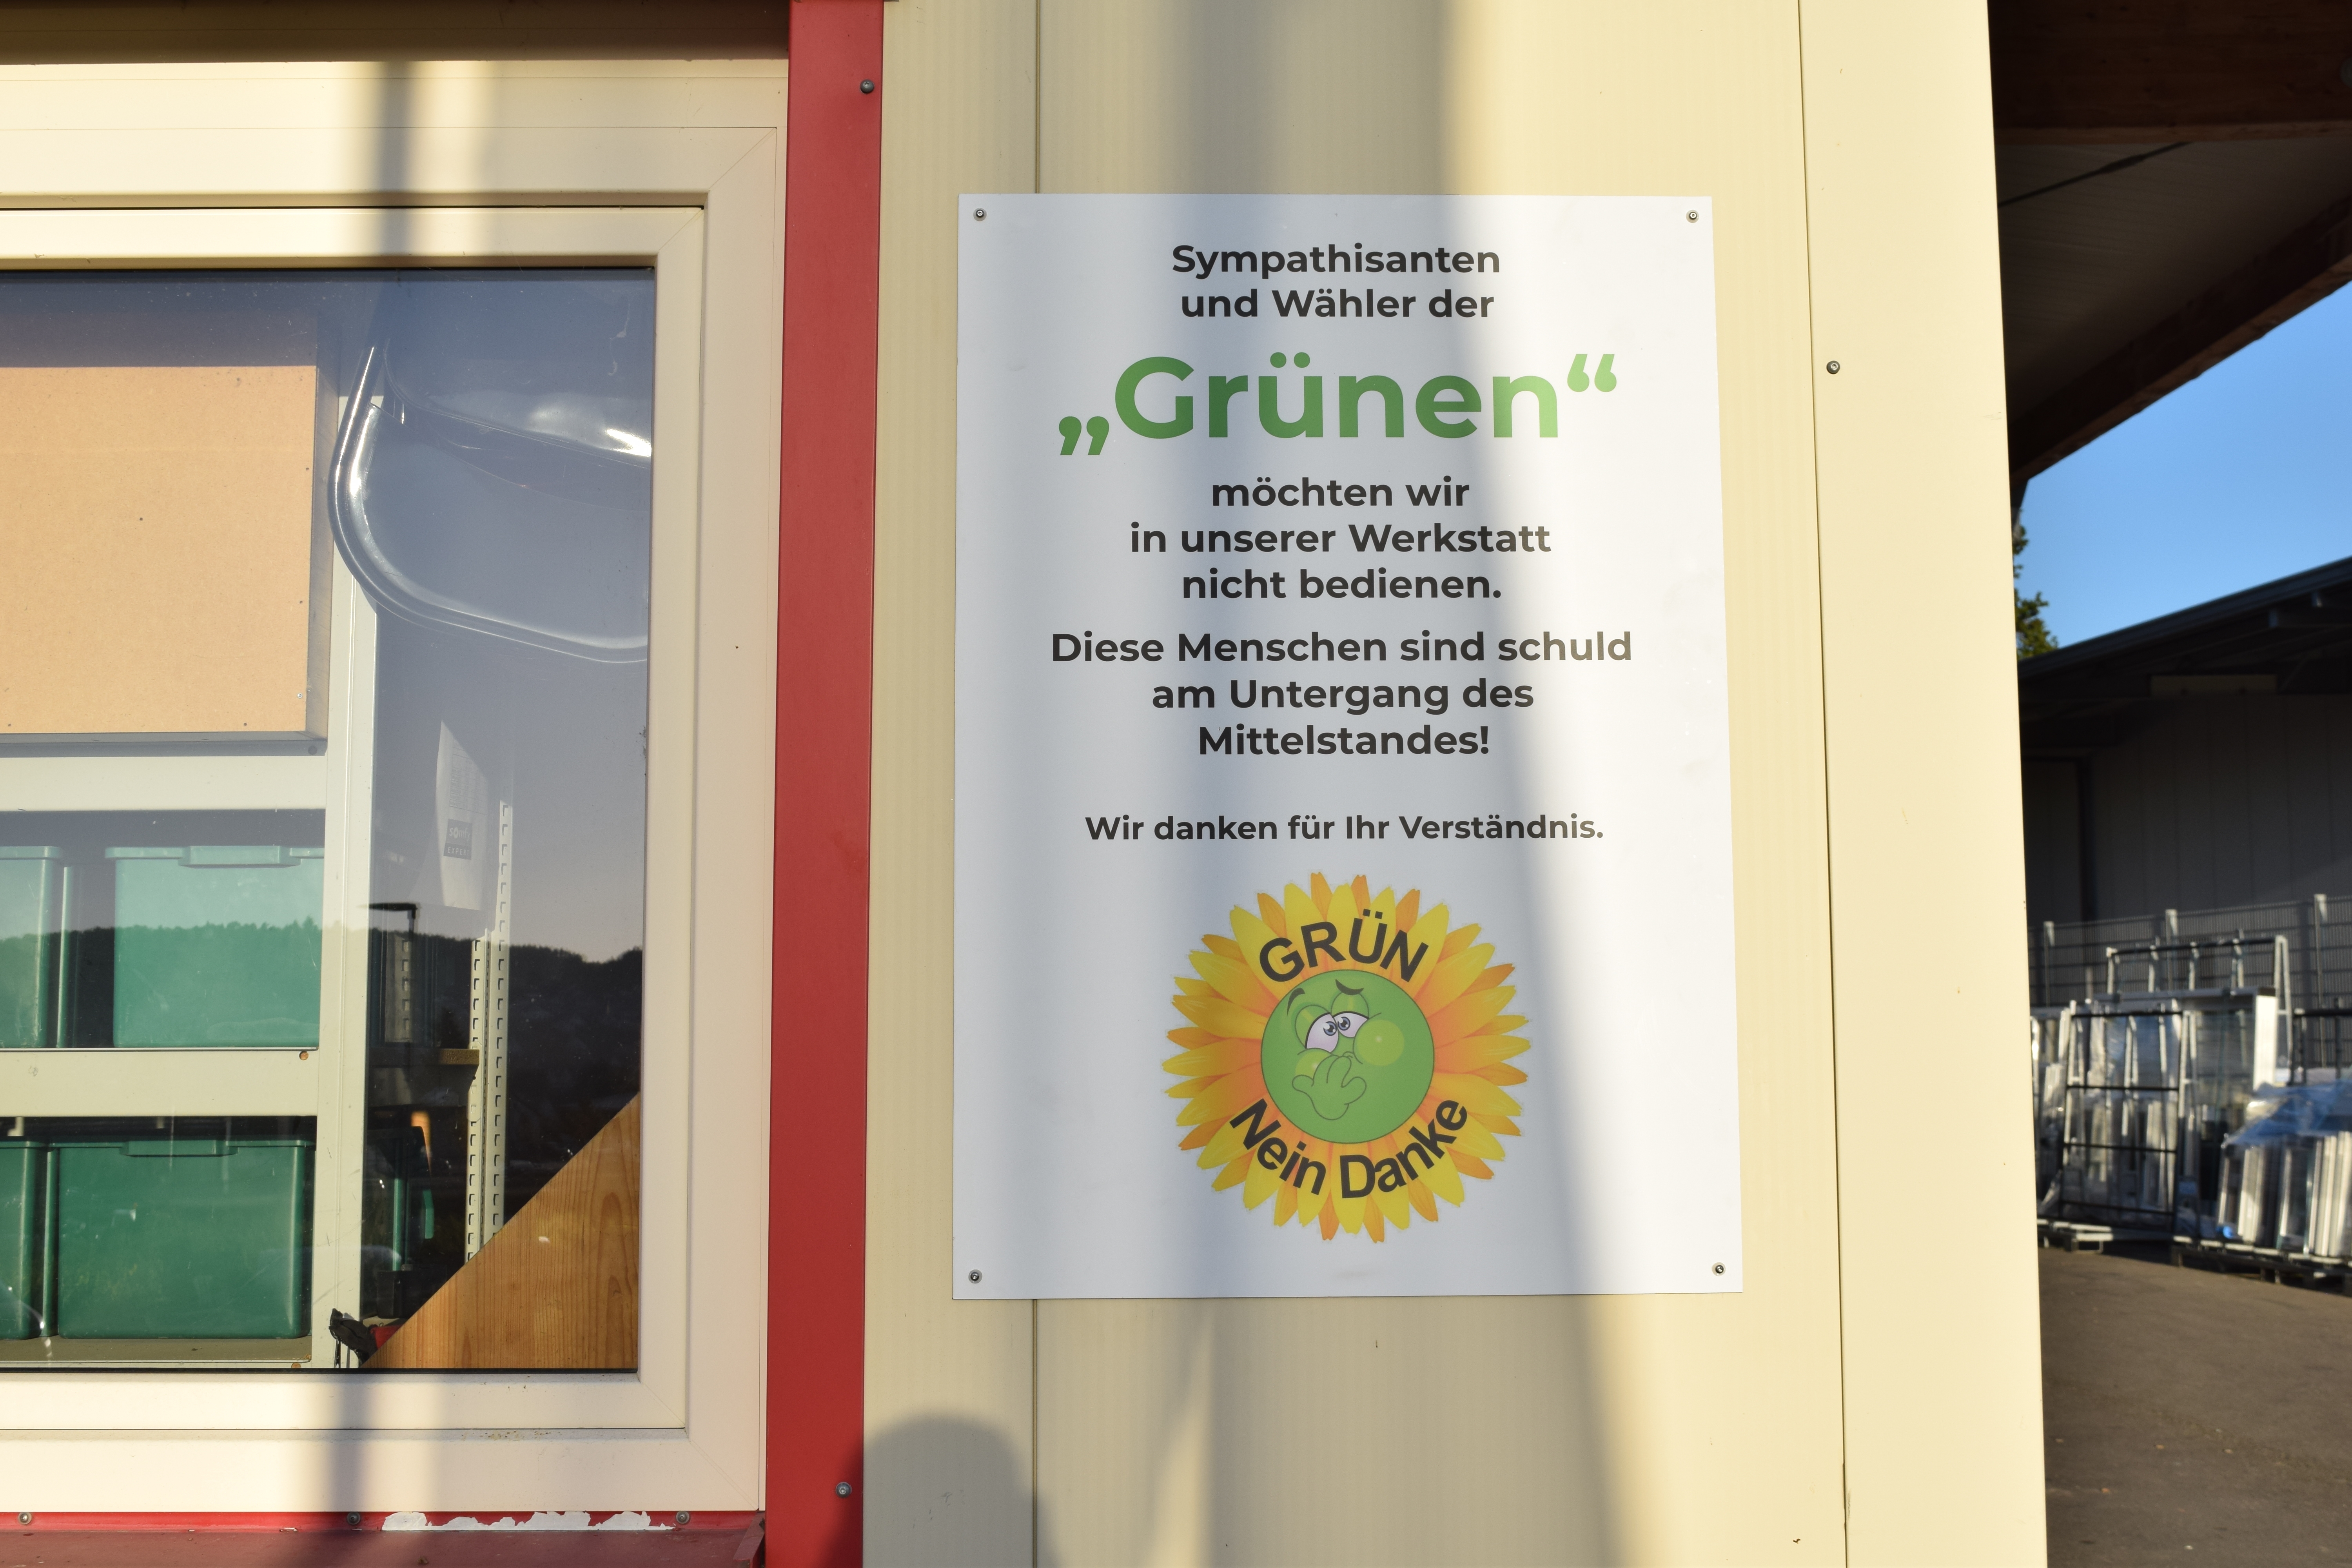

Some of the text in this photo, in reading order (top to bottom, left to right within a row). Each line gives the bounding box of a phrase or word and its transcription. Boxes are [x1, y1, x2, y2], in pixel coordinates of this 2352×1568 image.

[1172, 242, 1500, 280] Sympathisanten
[1181, 288, 1495, 318] und Wähler der
[1212, 475, 1470, 507] möchten wir
[1131, 521, 1552, 553] in unserer Werkstatt
[1183, 566, 1502, 599] nicht bedienen.
[1052, 629, 1632, 662] Diese Menschen sind schuld
[1152, 677, 1534, 716] am Untergang des
[1199, 722, 1489, 755] Mittelstandes!
[1084, 813, 1603, 840] Wir danken für Ihr Verständnis.
[1259, 909, 1429, 982] GRÜN
[1229, 1098, 1468, 1199] Nein Danke
